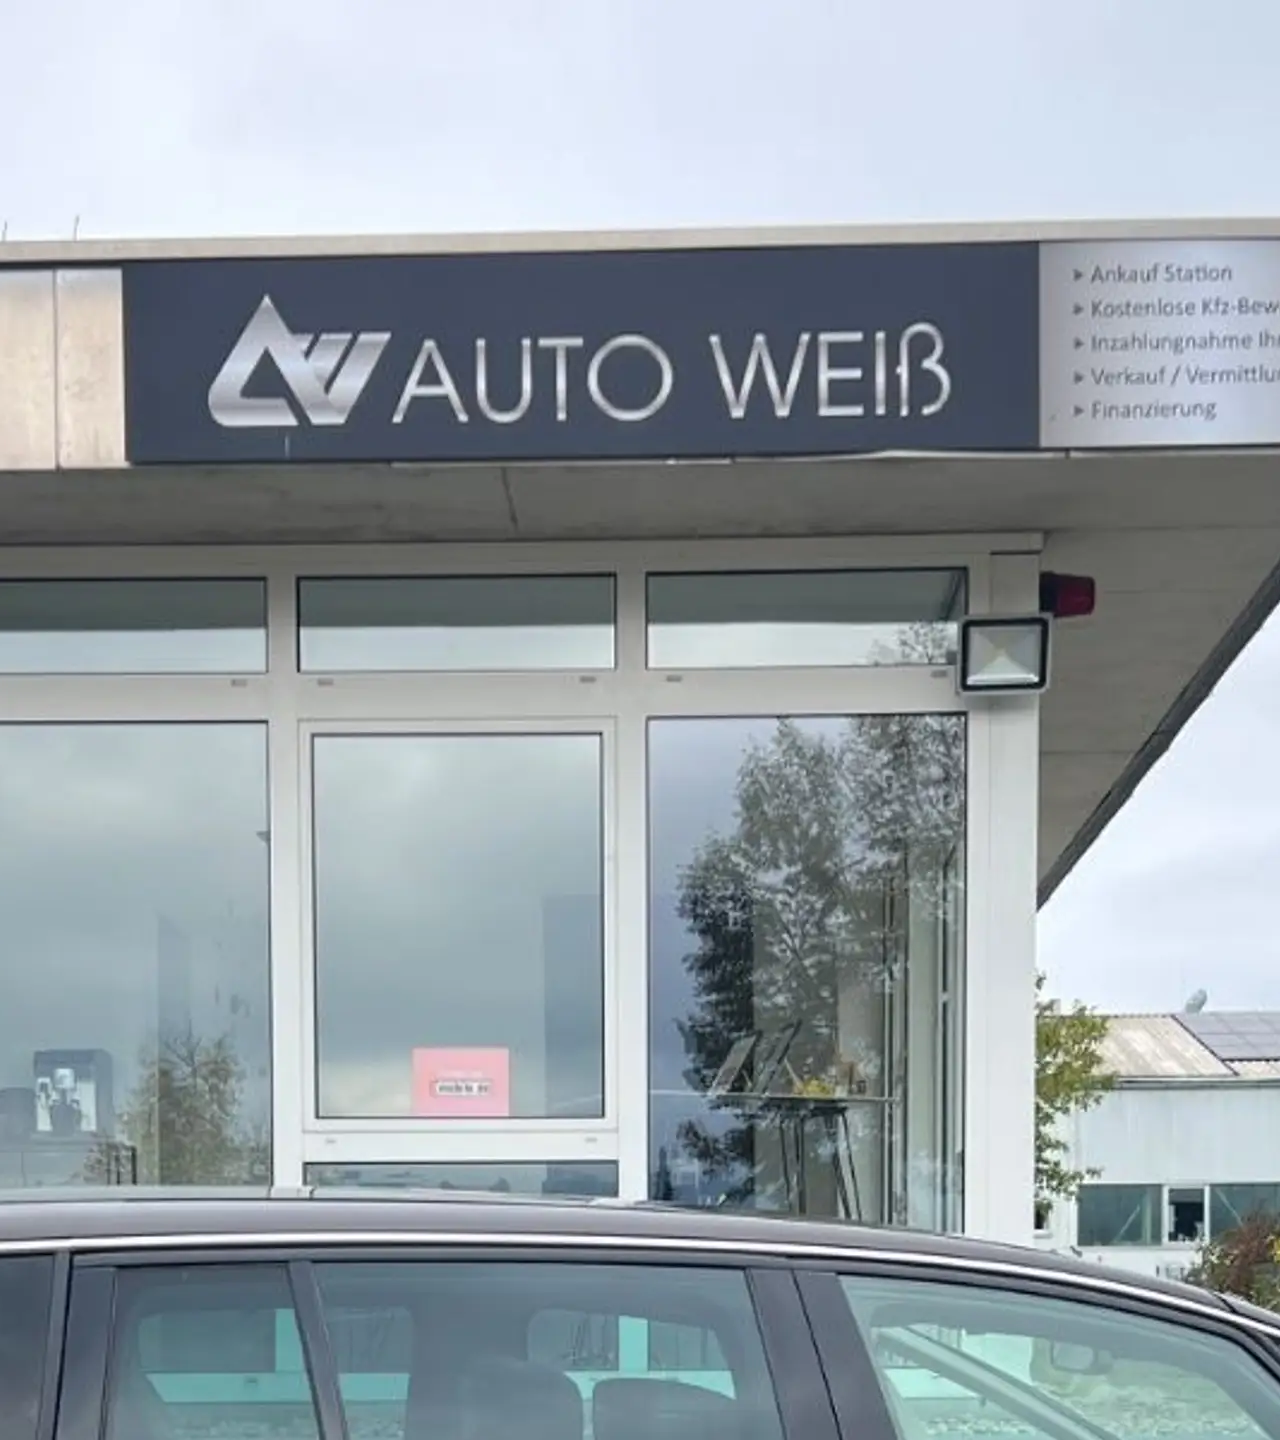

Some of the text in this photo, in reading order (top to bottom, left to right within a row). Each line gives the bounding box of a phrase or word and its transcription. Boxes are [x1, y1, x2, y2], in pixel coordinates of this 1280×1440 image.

[1090, 263, 1232, 284] Ankauf Station
[1090, 297, 1196, 317] Kostenlose
[1090, 332, 1253, 355] Inzahlungnahme
[392, 333, 673, 424] AUTO
[709, 321, 951, 420] WEIß
[1090, 367, 1166, 386] Verkauf
[1090, 400, 1218, 421] Finanzierung
